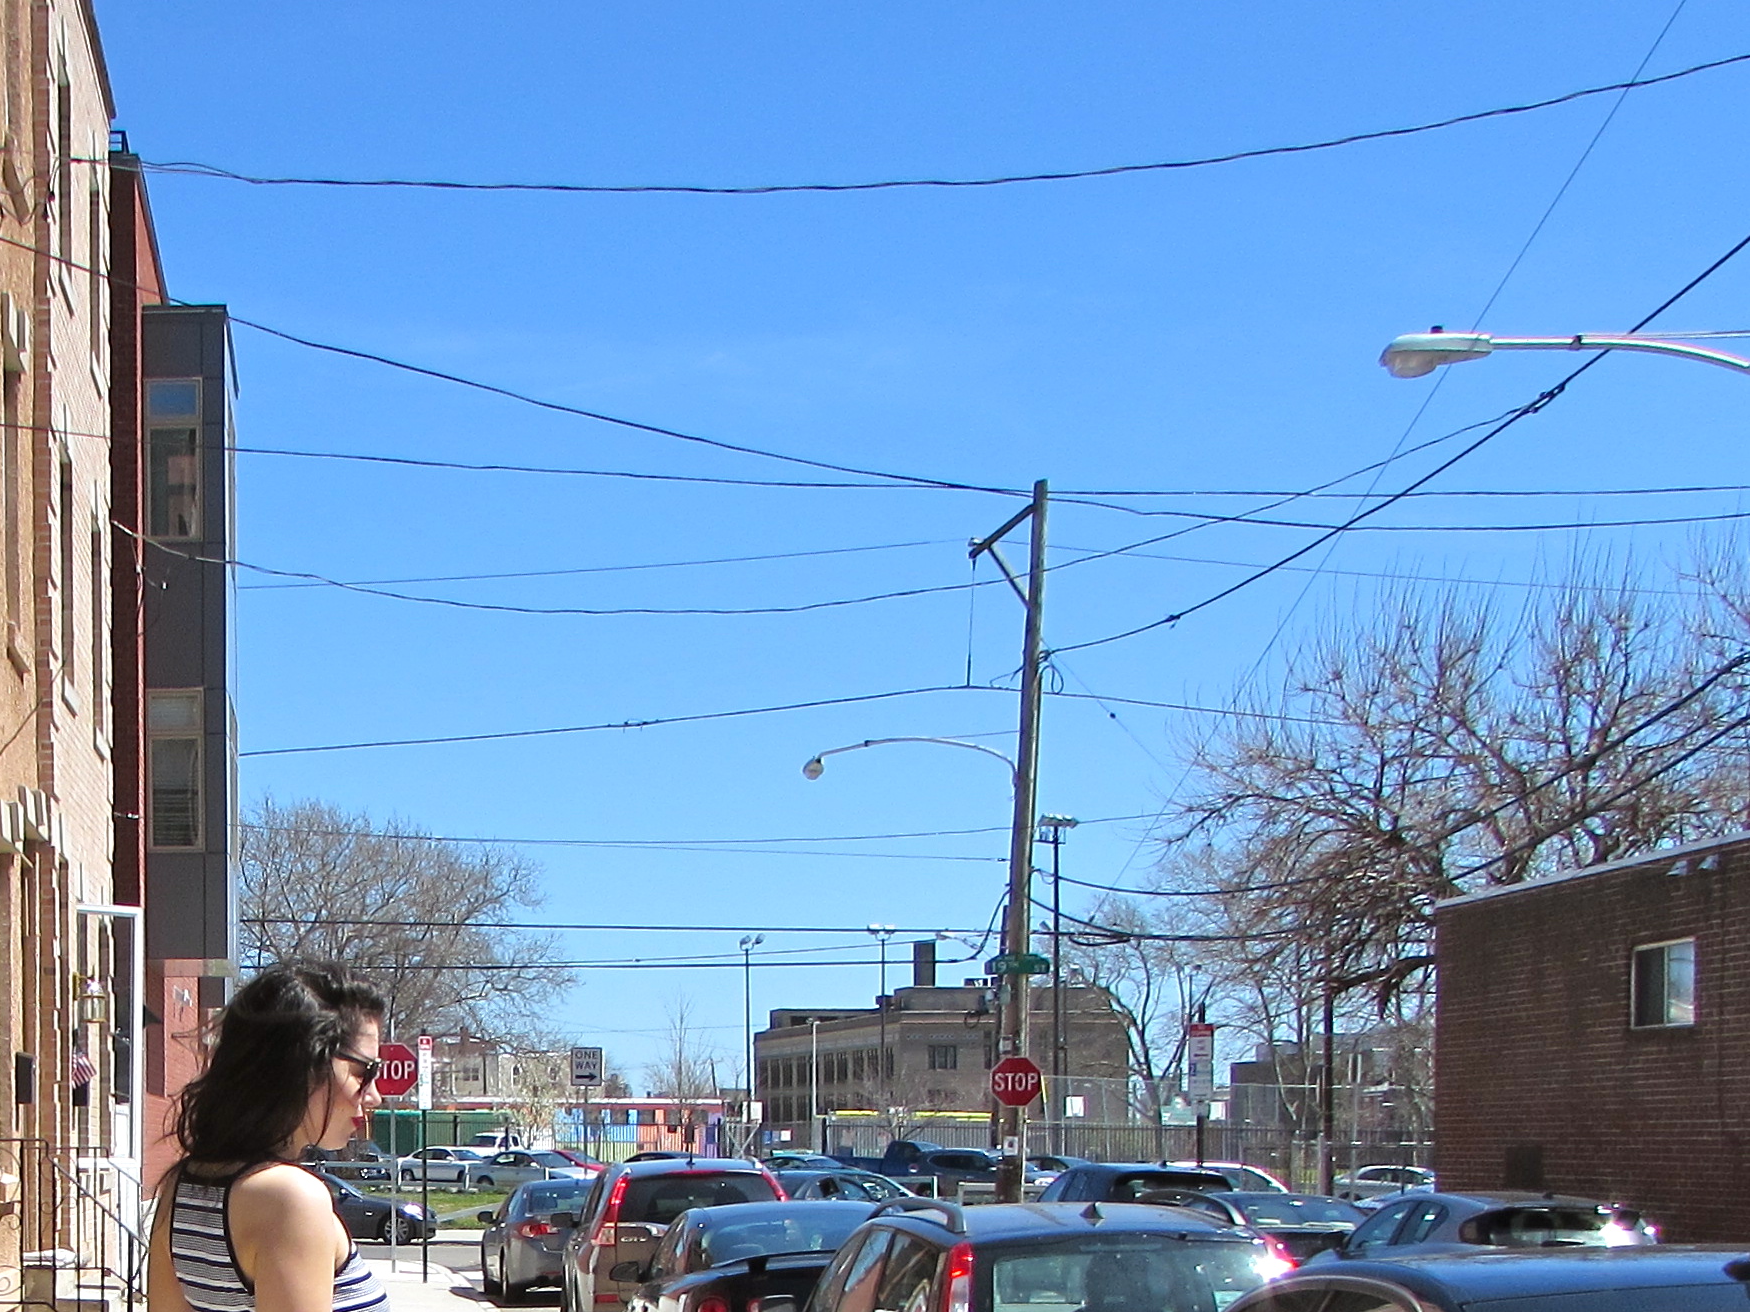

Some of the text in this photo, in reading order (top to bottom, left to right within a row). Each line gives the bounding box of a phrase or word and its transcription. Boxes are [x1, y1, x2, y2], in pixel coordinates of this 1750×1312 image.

[575, 1050, 598, 1060] ONE
[382, 1060, 415, 1080] TOP
[575, 1061, 598, 1070] WAY
[993, 1072, 1039, 1092] STOP
